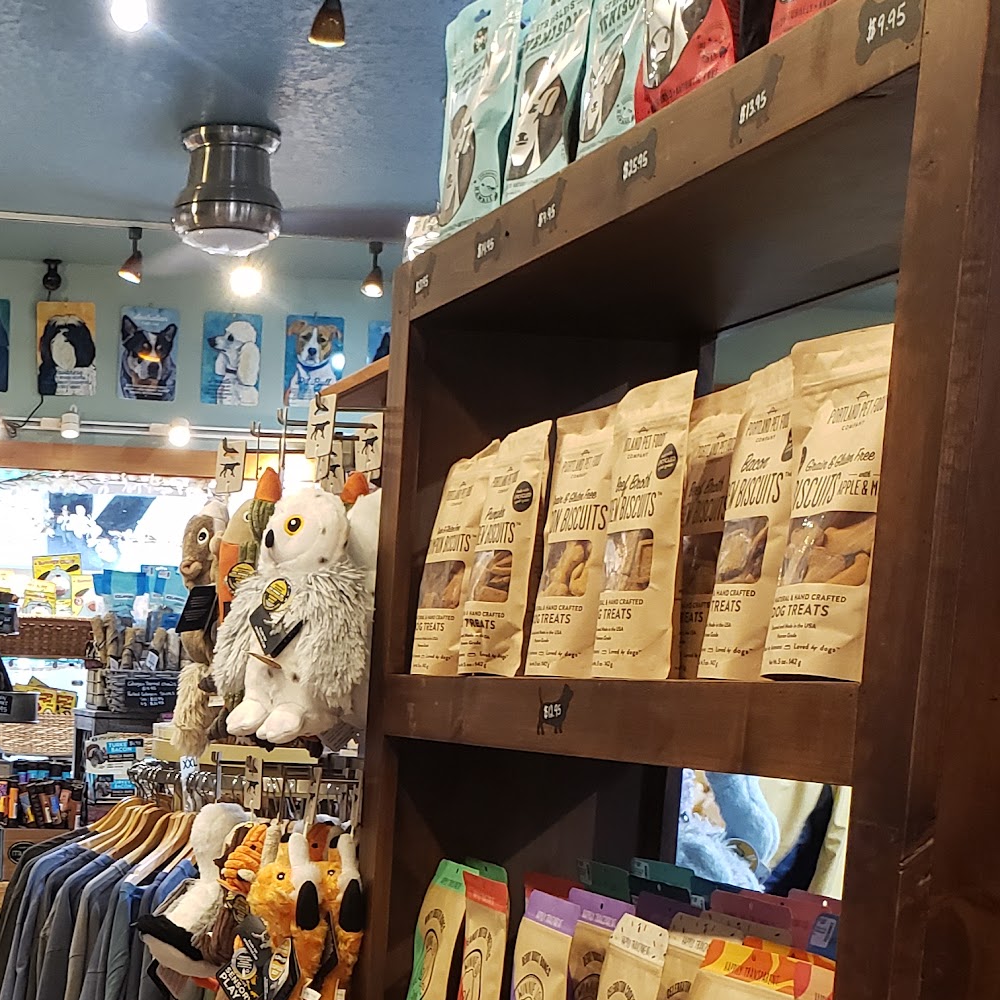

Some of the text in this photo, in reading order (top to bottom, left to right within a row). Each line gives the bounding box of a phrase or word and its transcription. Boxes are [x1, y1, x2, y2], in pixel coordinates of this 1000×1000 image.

[866, 3, 906, 44] $9.95
[827, 400, 874, 425] PORTLAND PET
[841, 420, 866, 431] COMPANY
[854, 447, 876, 461] Free
[740, 452, 771, 473] Bacon
[734, 472, 784, 509] BISCUITS
[861, 480, 868, 496] &
[618, 492, 657, 519] BISCUITS
[559, 504, 609, 532] BISCUITS
[730, 589, 756, 598] CRAFTED
[811, 593, 847, 603] CRAFTED
[619, 598, 644, 606] CRAFTED
[711, 599, 741, 612] TREATS
[557, 604, 583, 613] CRAFTED
[604, 608, 632, 620] TREATS
[787, 604, 830, 617] TREATS
[481, 611, 505, 619] CRAFTED
[540, 613, 571, 625] TREATS
[427, 622, 445, 632] TREATS
[464, 618, 496, 630] TREATS
[820, 645, 837, 655] dogs
[108, 741, 128, 749] TURKE
[182, 759, 198, 770] XXL
[743, 964, 780, 986] TRANSPARENT
[219, 971, 242, 999] PLAY
